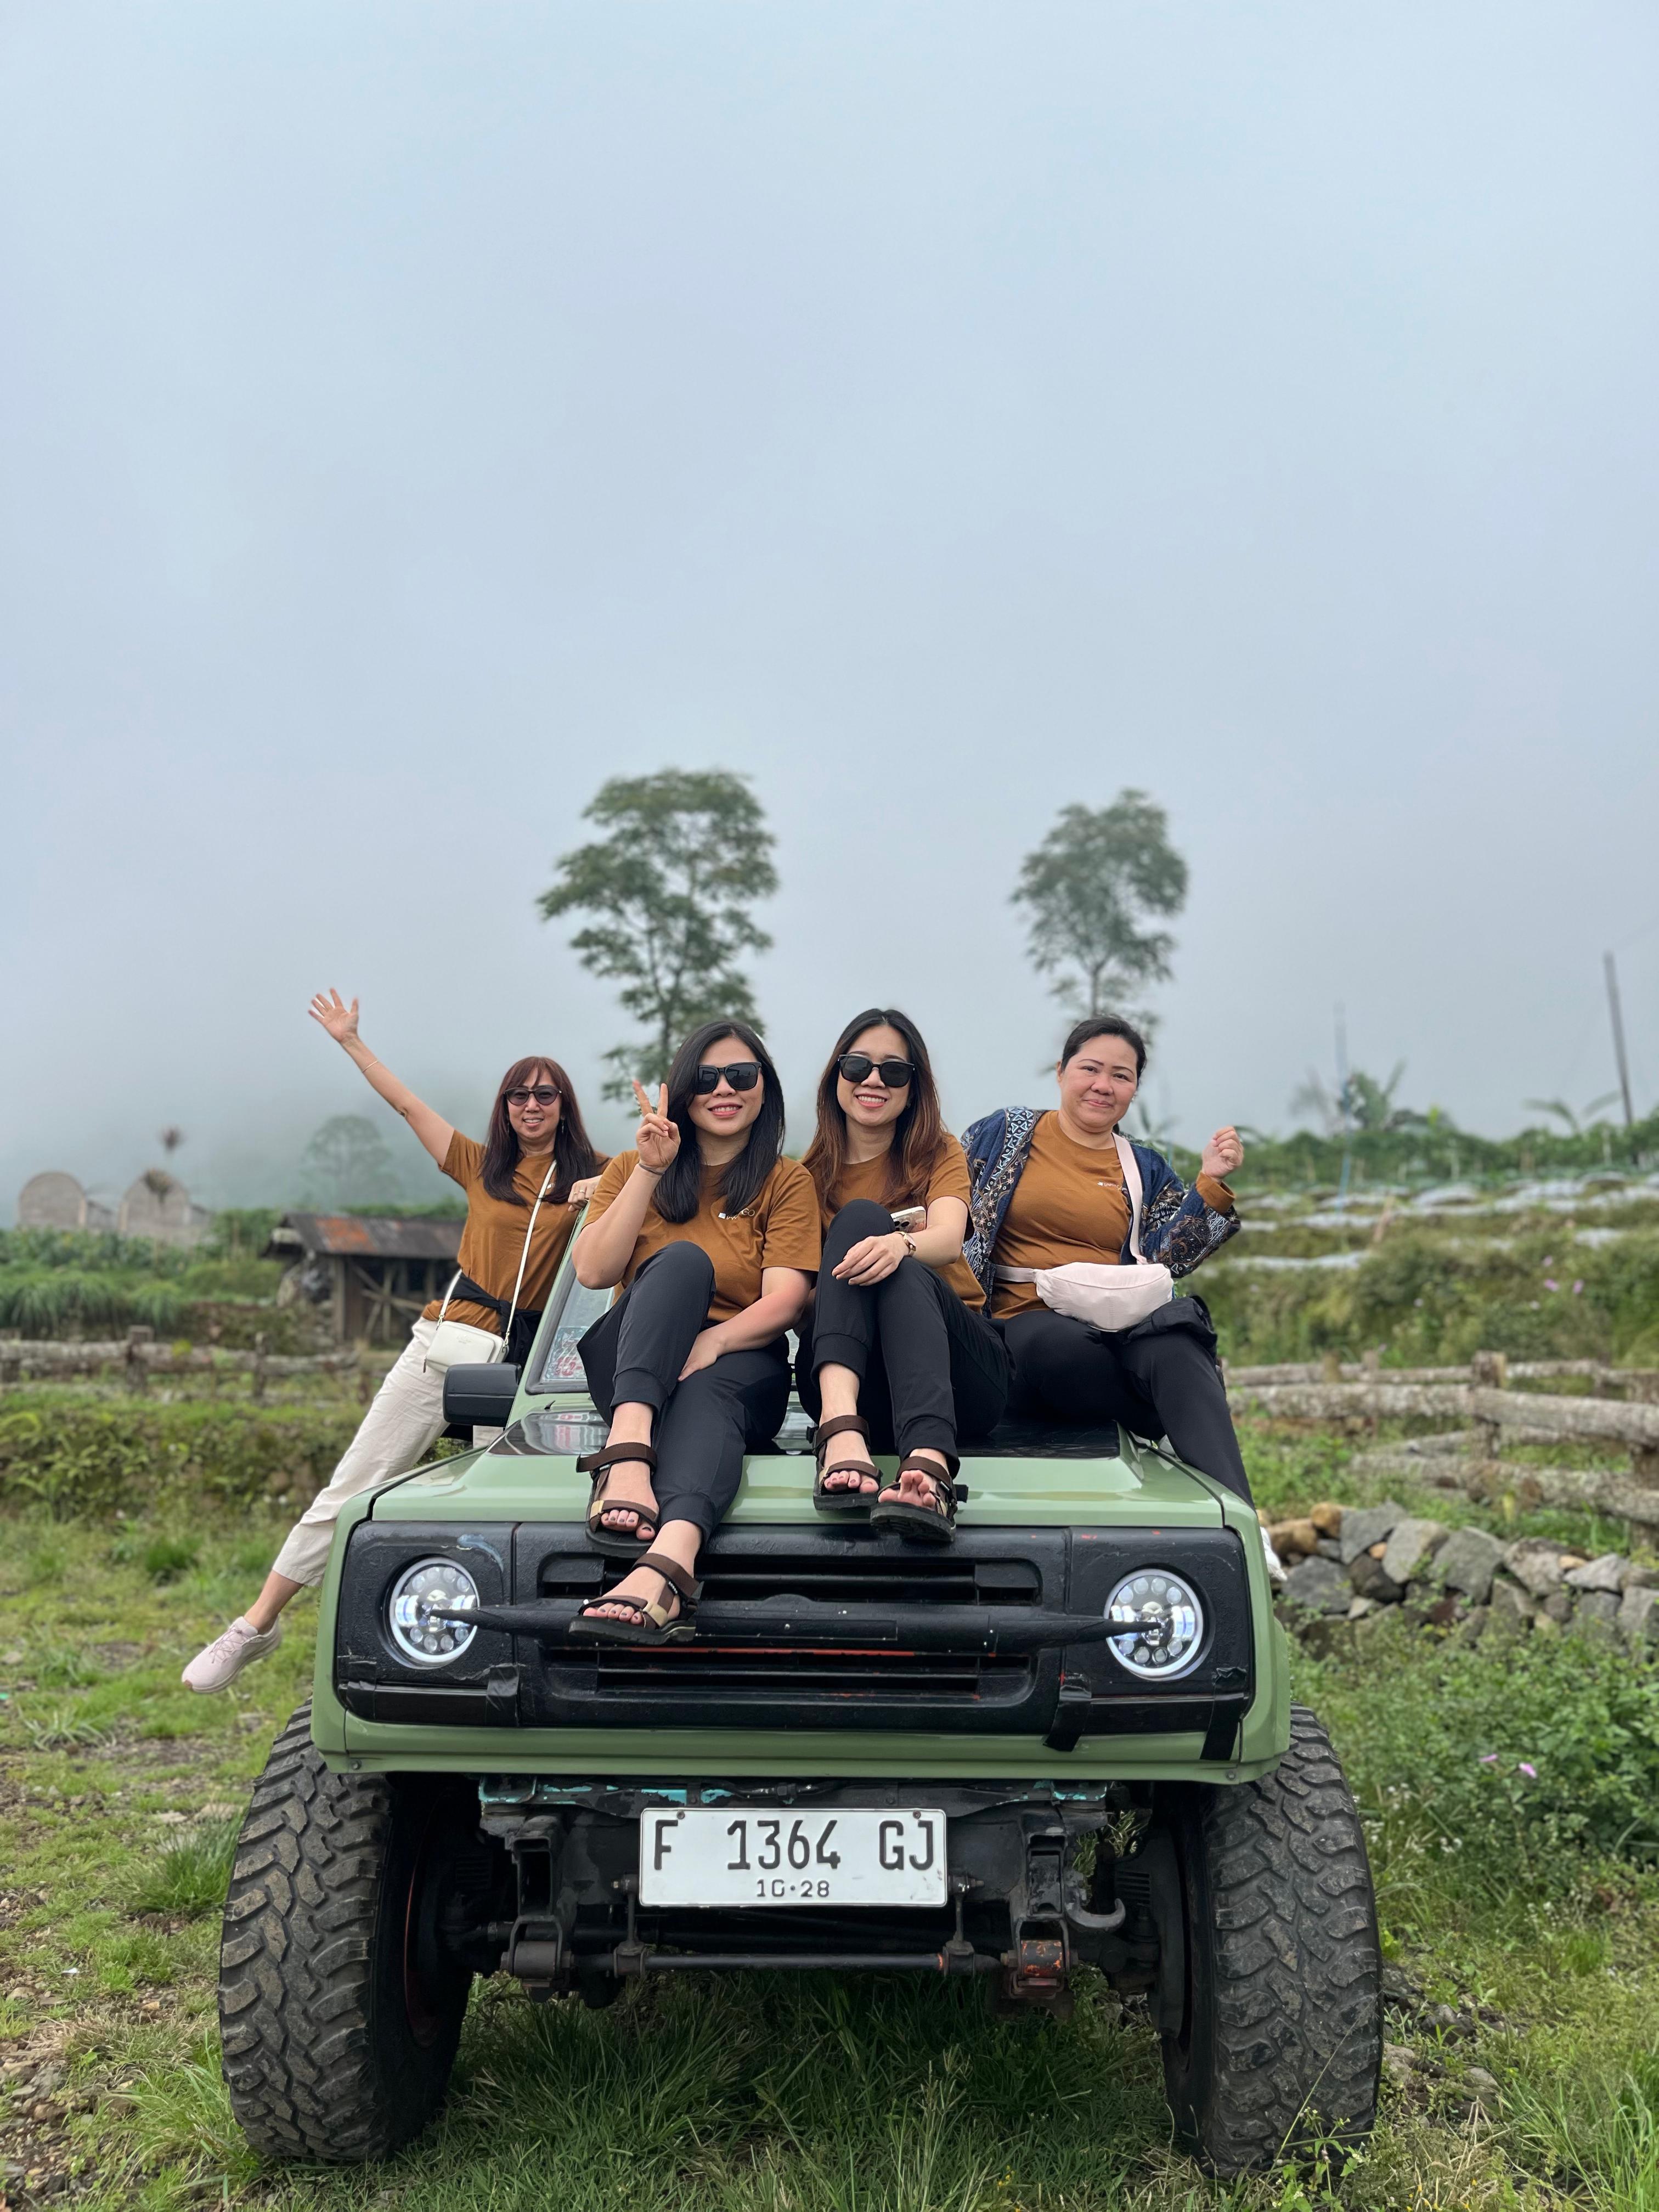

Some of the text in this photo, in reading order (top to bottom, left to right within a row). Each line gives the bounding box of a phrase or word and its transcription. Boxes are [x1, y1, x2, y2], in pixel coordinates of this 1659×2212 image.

[654, 1819, 934, 1871] F 1364 GJ
